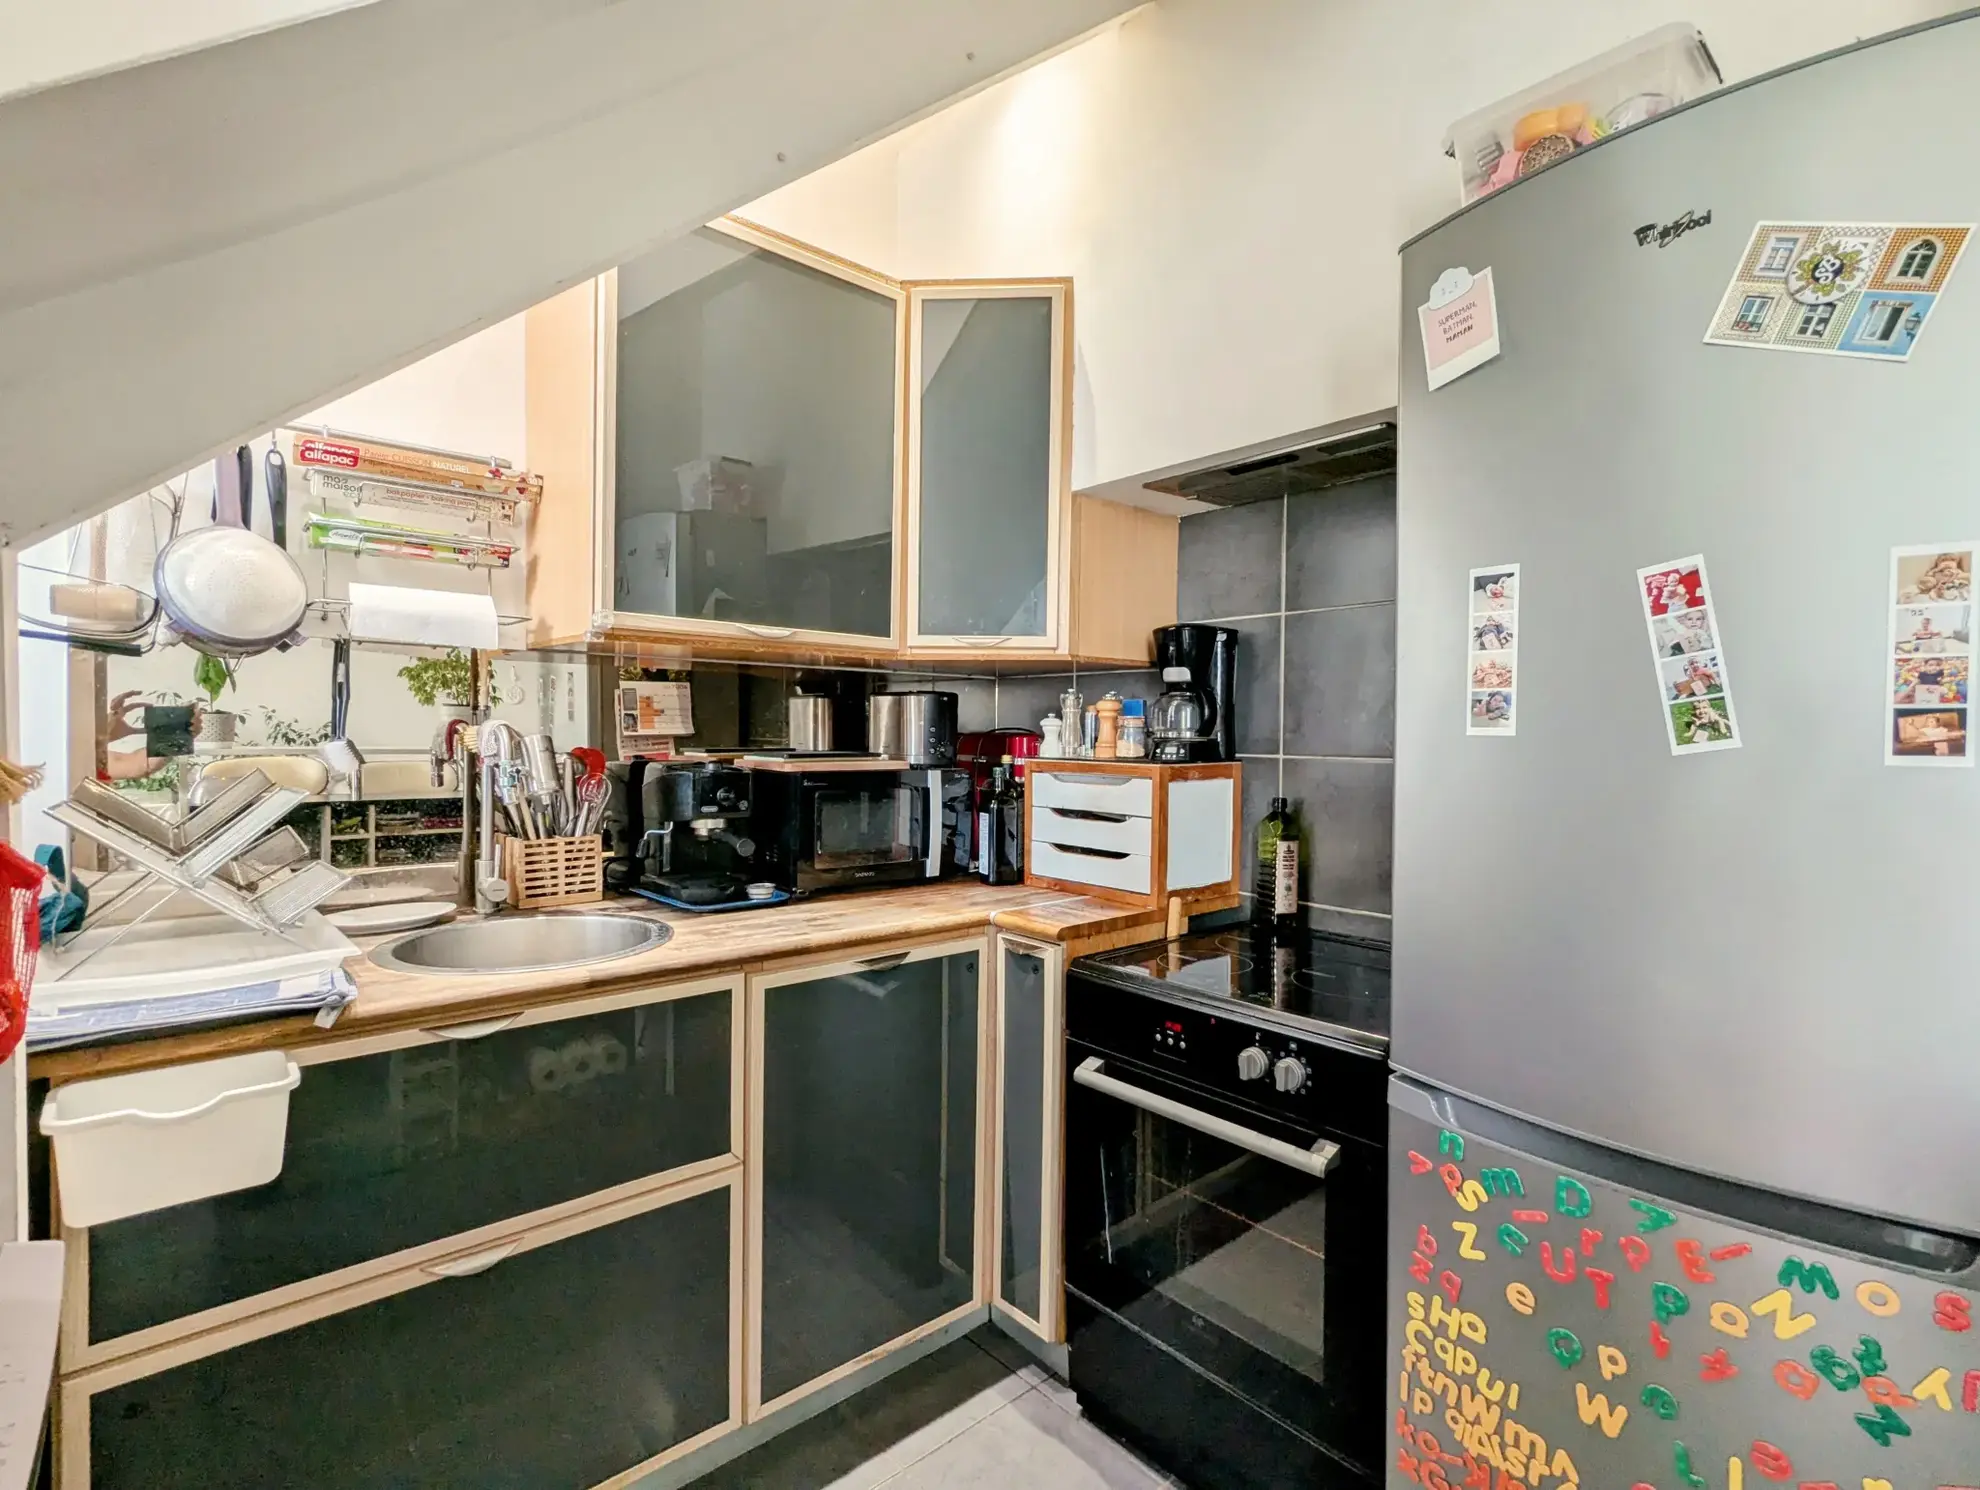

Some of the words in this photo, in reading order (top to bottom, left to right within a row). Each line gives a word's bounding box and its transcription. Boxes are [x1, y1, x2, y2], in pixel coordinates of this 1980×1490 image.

[1446, 324, 1473, 344] MAMAN
[304, 449, 355, 466] alfapac
[433, 459, 471, 474] NATUREL
[1555, 1175, 1592, 1218] D
[1675, 1239, 1716, 1284] E
[1505, 1282, 1537, 1316] e
[1585, 1266, 1615, 1310] T
